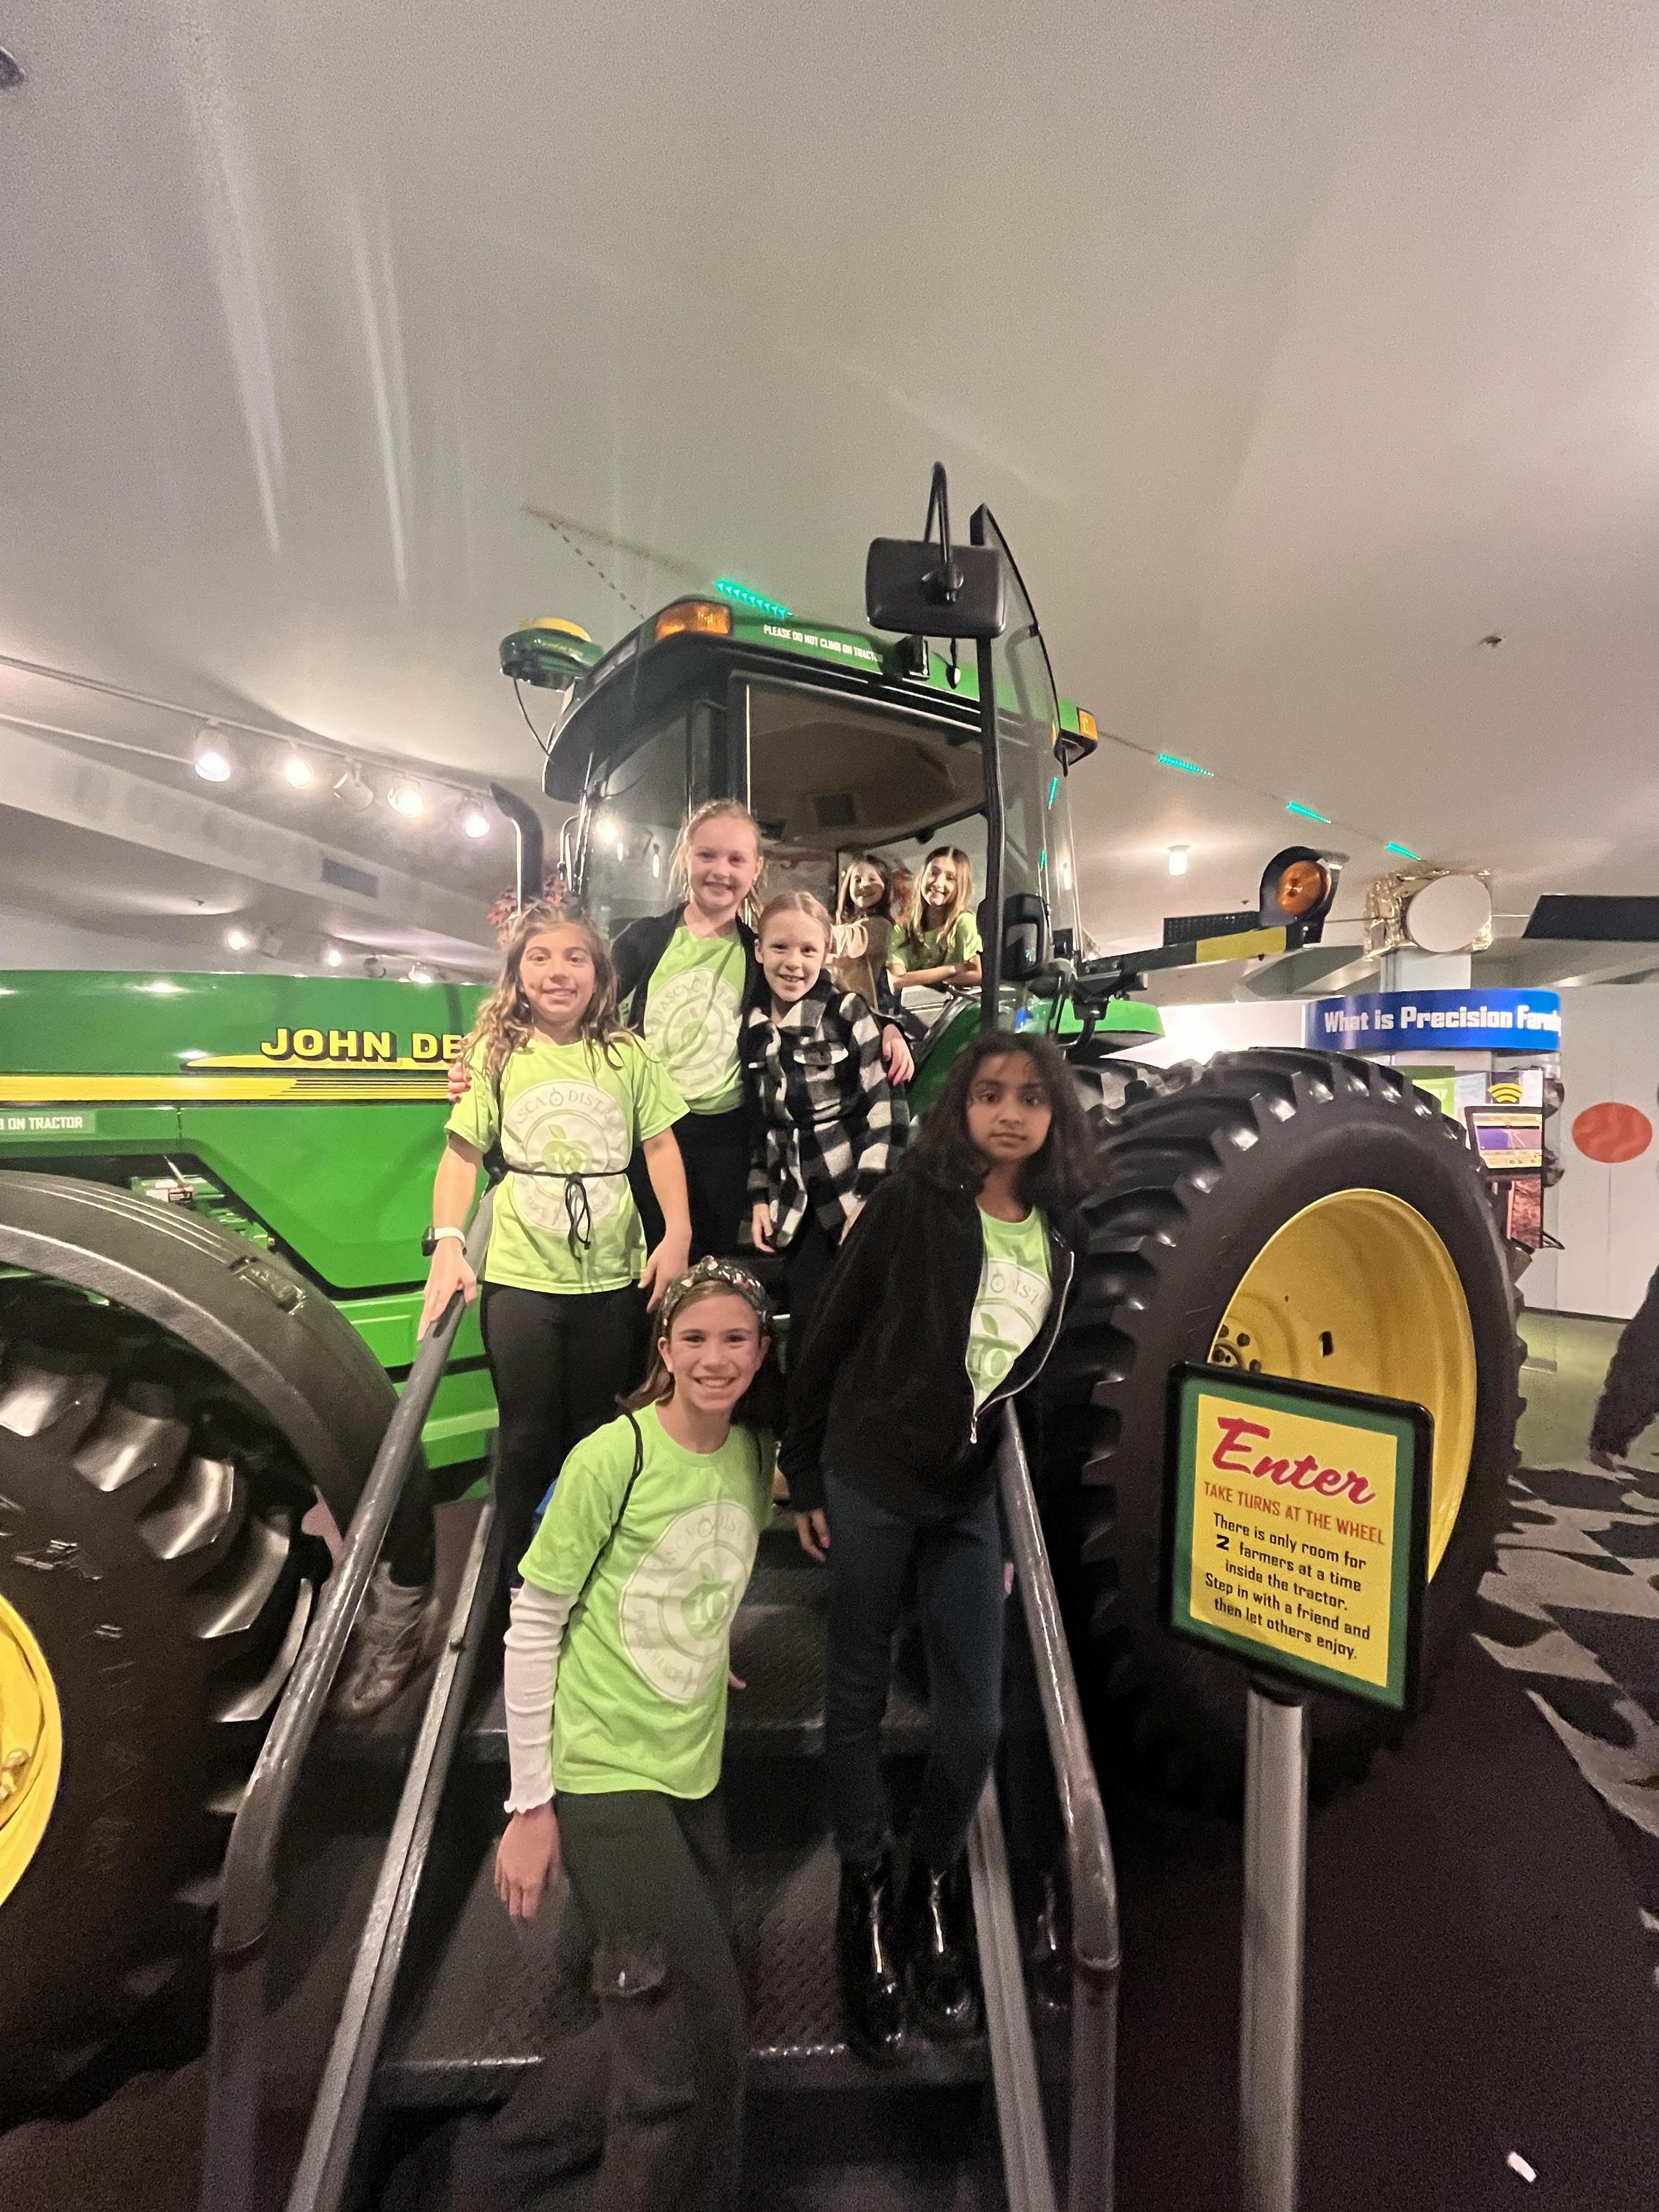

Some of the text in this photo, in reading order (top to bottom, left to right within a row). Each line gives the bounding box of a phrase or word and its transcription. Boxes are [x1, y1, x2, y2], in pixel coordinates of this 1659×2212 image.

[764, 625, 878, 662] PLEASE DO NOT CLIMB ON TRACT
[261, 1028, 396, 1061] JOHN
[1325, 1011, 1369, 1033] What
[1374, 1009, 1394, 1030] is
[1401, 1006, 1513, 1029] Precision
[8, 1117, 26, 1130] ON
[29, 1116, 83, 1130] TRACTOR
[971, 1344, 1012, 1378] 10
[1212, 1416, 1376, 1505] Enter
[1204, 1481, 1385, 1545] TAKE TURNS AT THE WHEEL
[1214, 1512, 1366, 1570] There is only room for
[1216, 1533, 1361, 1592] 2 farmers at a time
[689, 1590, 729, 1625] 10
[1205, 1572, 1372, 1641] Step in with a friend and
[1225, 1560, 1347, 1611] inside the tractor.
[1214, 1597, 1358, 1660] then let others enjoy.
